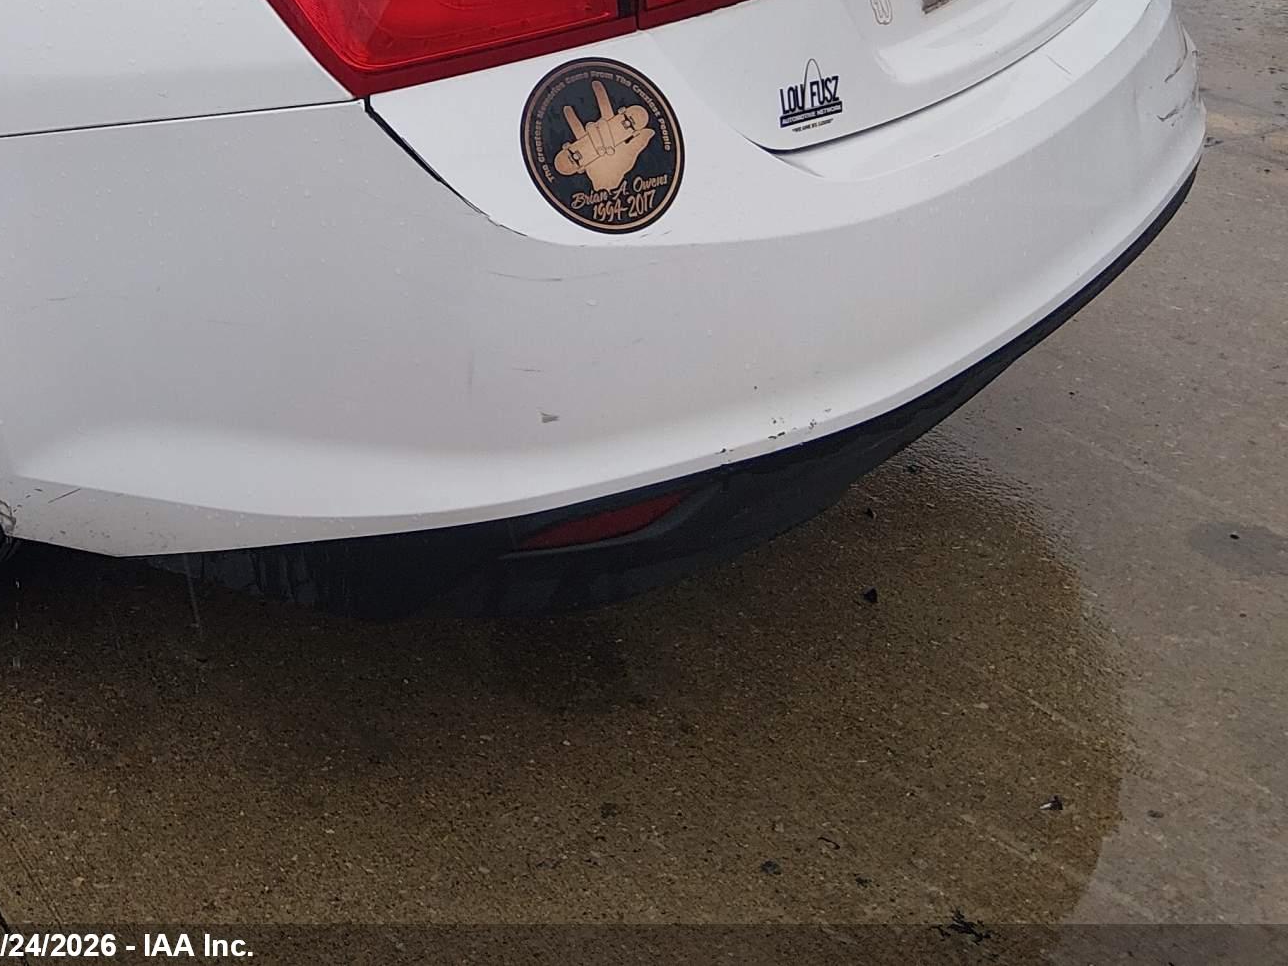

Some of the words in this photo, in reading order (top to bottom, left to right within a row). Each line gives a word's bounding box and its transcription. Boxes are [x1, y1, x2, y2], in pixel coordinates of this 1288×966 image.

[779, 83, 805, 115] LOU
[809, 75, 840, 108] FUSZ
[572, 189, 608, 210] Brian
[592, 189, 656, 222] 1994-2017
